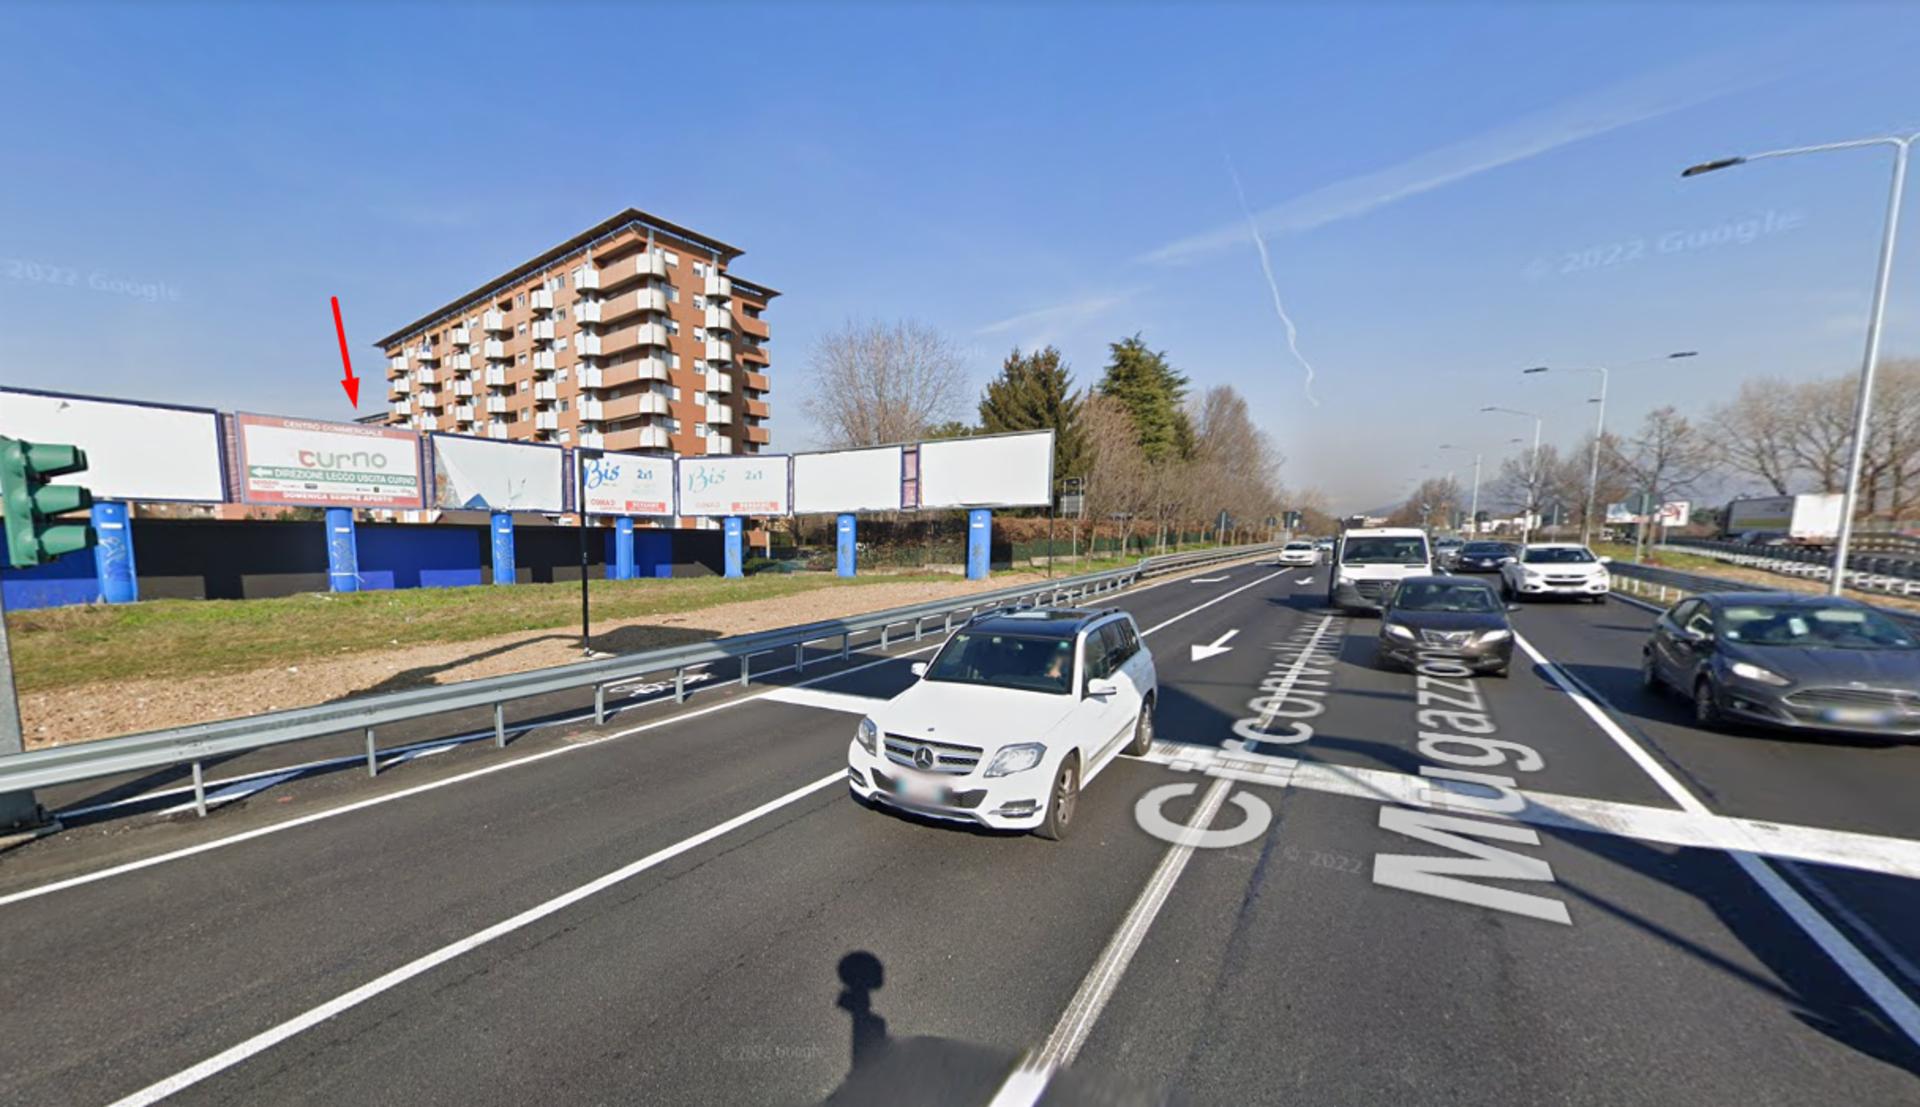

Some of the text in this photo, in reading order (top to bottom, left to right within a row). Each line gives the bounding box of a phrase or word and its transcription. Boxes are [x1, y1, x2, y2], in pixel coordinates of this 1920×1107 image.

[274, 468, 416, 486] DIREZIONE LECCO USCITA CURNO
[584, 458, 621, 489] Bis
[283, 491, 328, 500] DOMENICA
